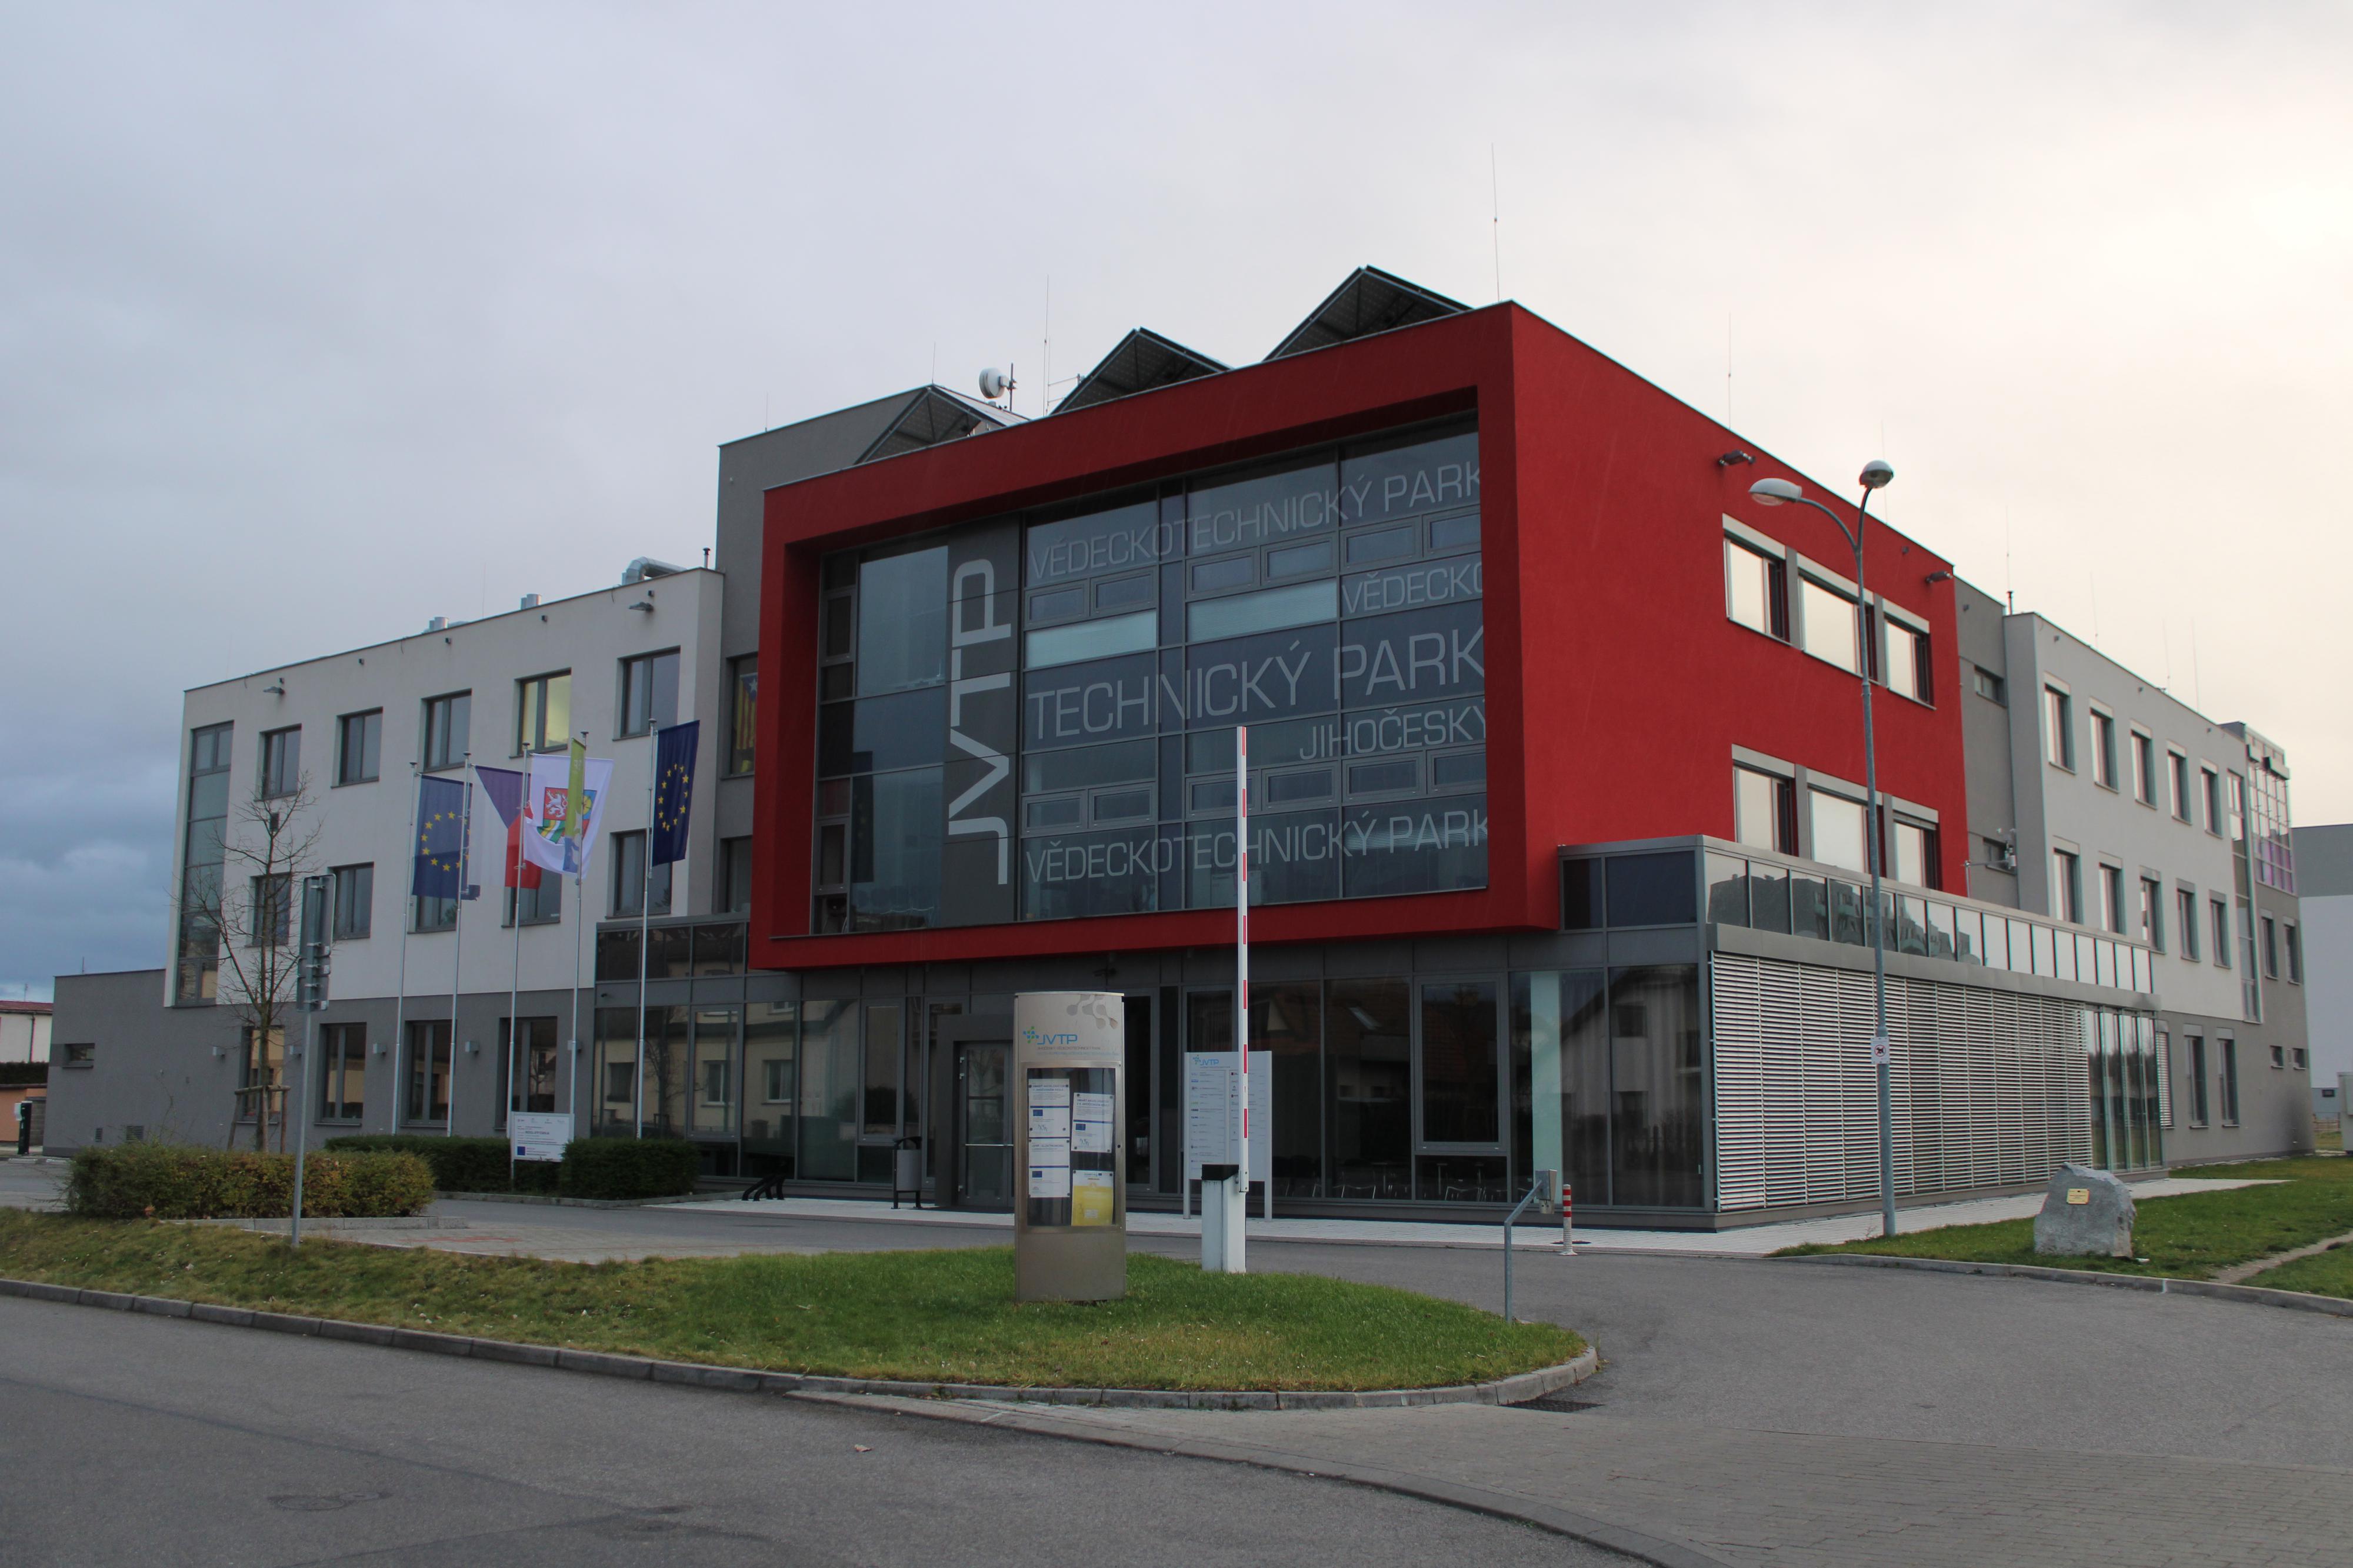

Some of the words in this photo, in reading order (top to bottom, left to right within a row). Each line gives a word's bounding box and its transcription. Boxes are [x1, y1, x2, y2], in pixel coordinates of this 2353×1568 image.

[1031, 473, 1373, 579] VĚDECKOTECHNICKÝ
[1384, 461, 1480, 512] PARK
[948, 558, 1011, 885] JVTP
[1027, 639, 1311, 739] TECHNICKÝ
[1334, 625, 1485, 700] PARK
[1389, 809, 1488, 853] PARK
[1036, 1033, 1078, 1045] JVTP
